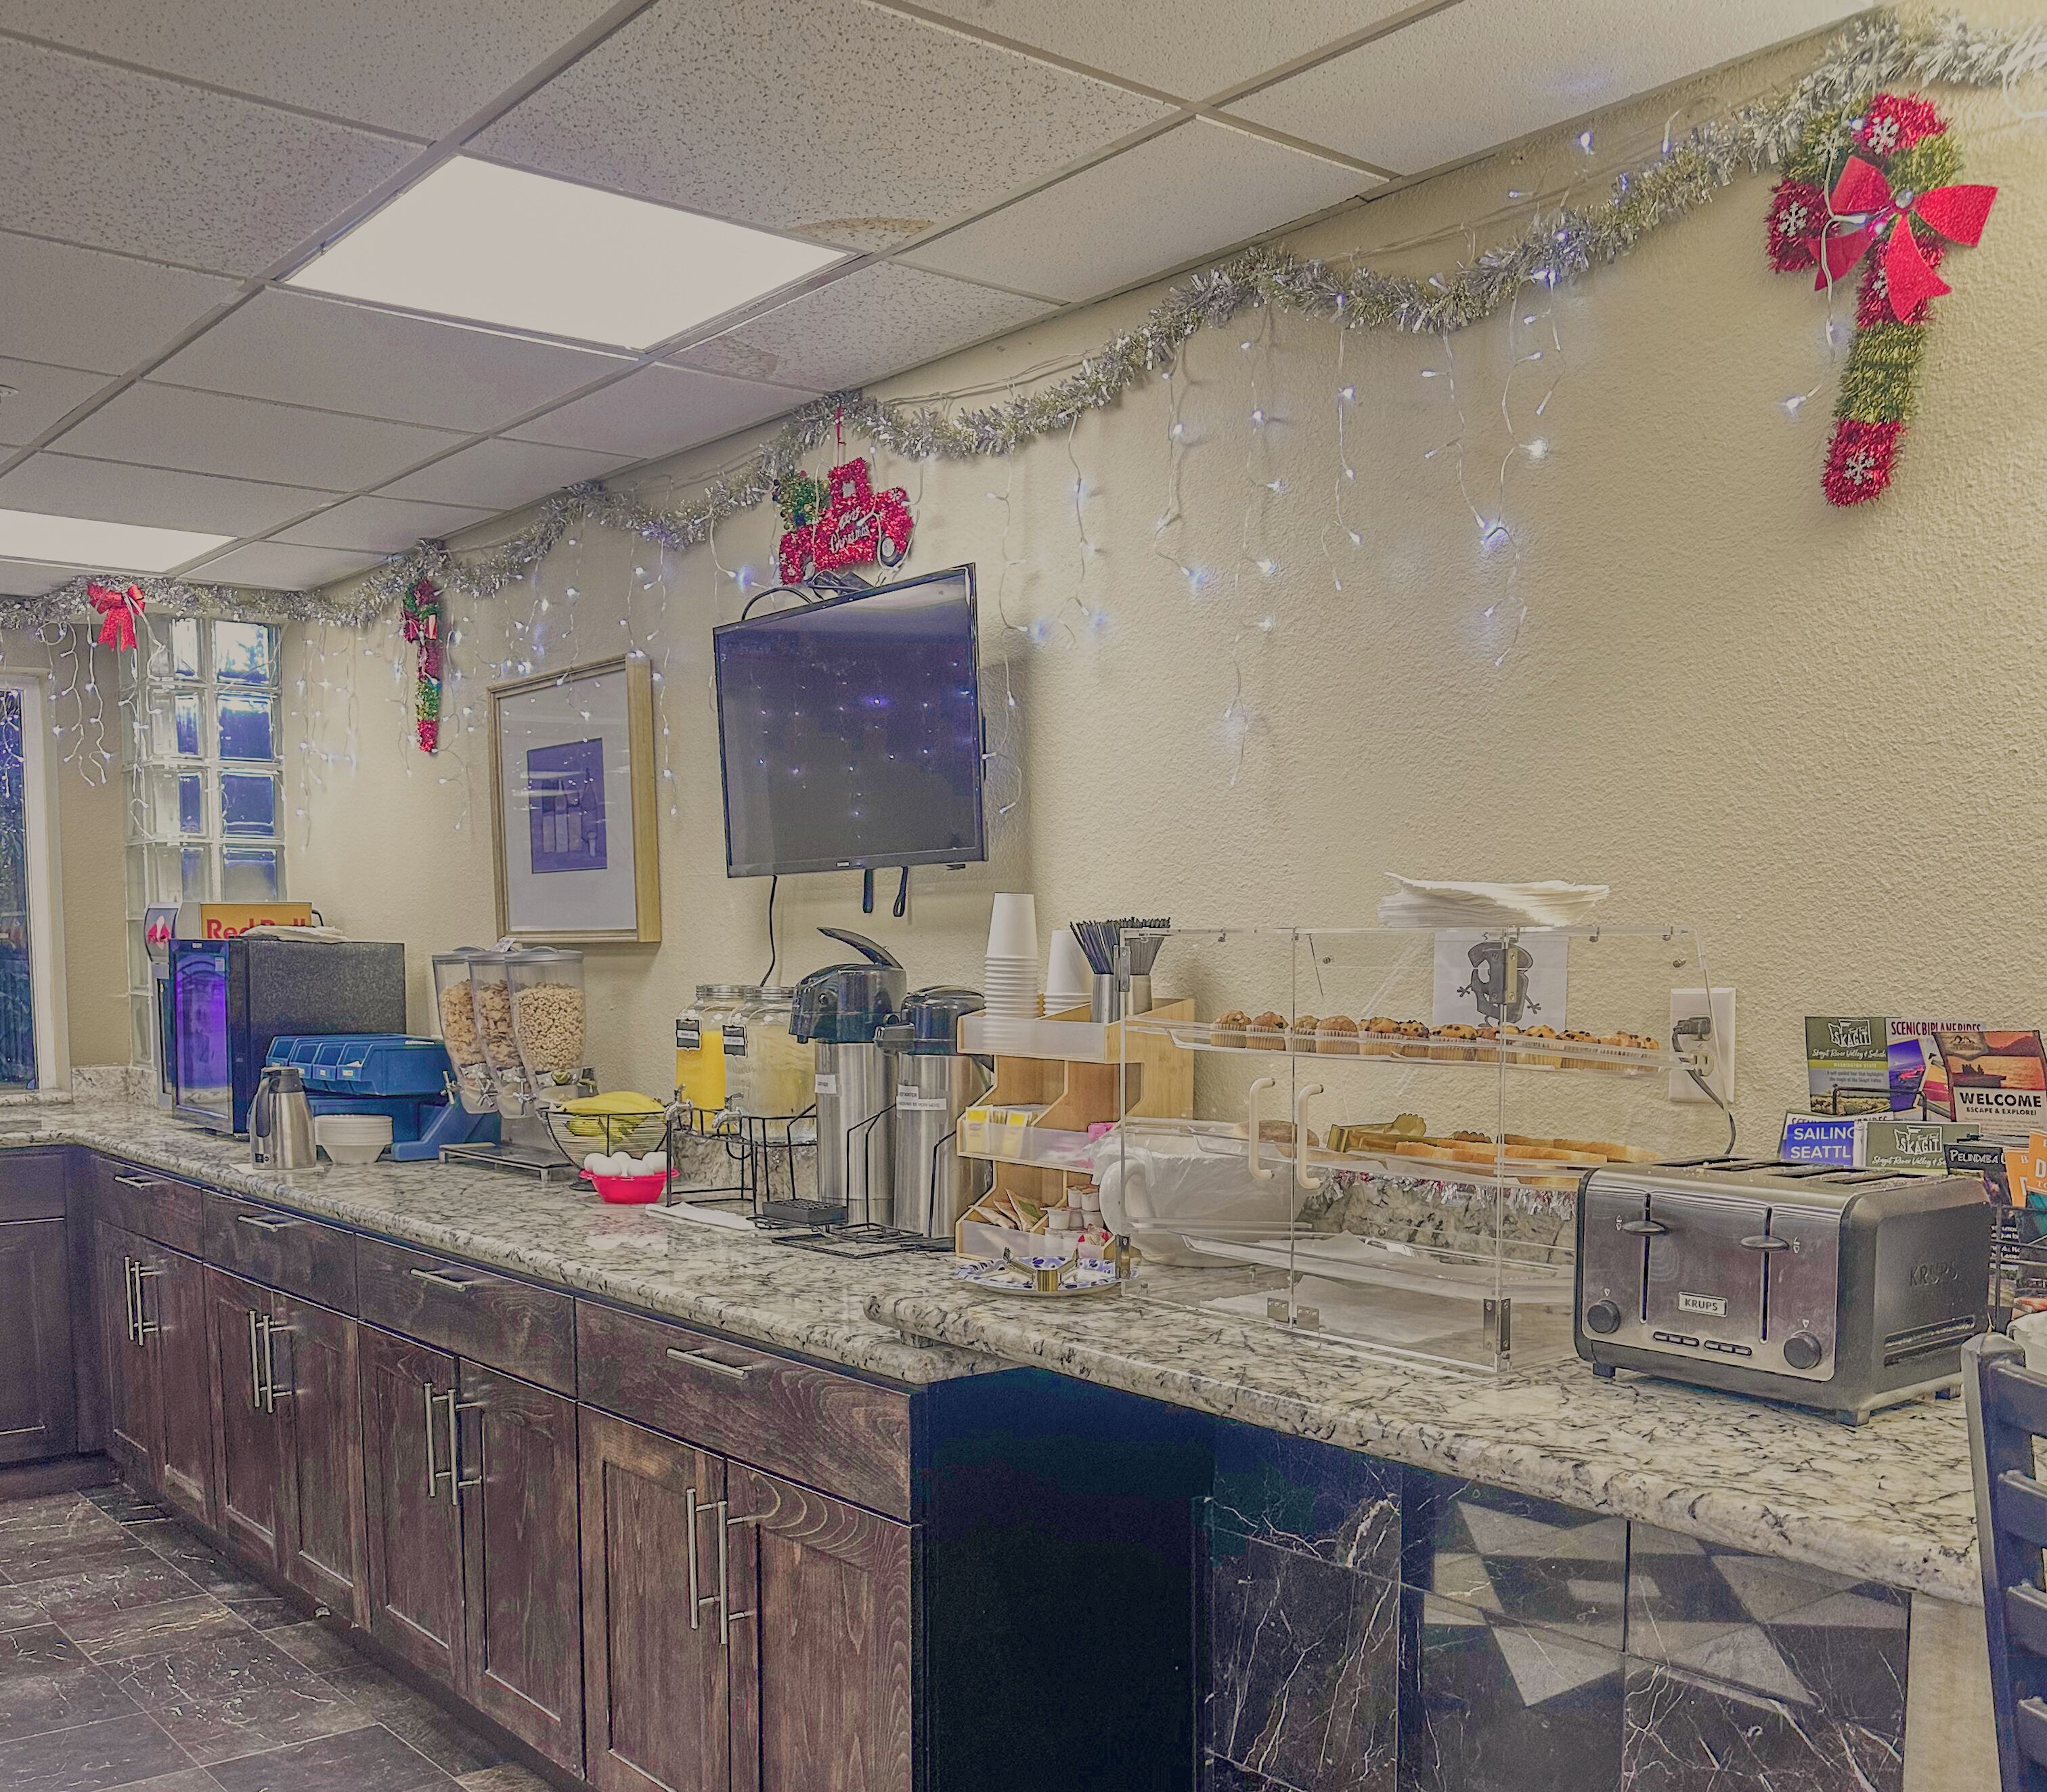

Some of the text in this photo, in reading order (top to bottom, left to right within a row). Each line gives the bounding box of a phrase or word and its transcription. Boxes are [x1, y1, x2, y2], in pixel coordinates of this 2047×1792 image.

[1833, 1031, 1869, 1047] SKAGIT
[1960, 1092, 2042, 1108] WELCOME
[1794, 1126, 1854, 1141] SAILING
[1790, 1145, 1851, 1159] SEATTL
[1900, 1137, 1939, 1155] SKAGIT
[1949, 1149, 1999, 1164] PELINDABA
[1910, 1261, 1959, 1286] KRUPS
[1685, 1298, 1718, 1311] KRUPS
